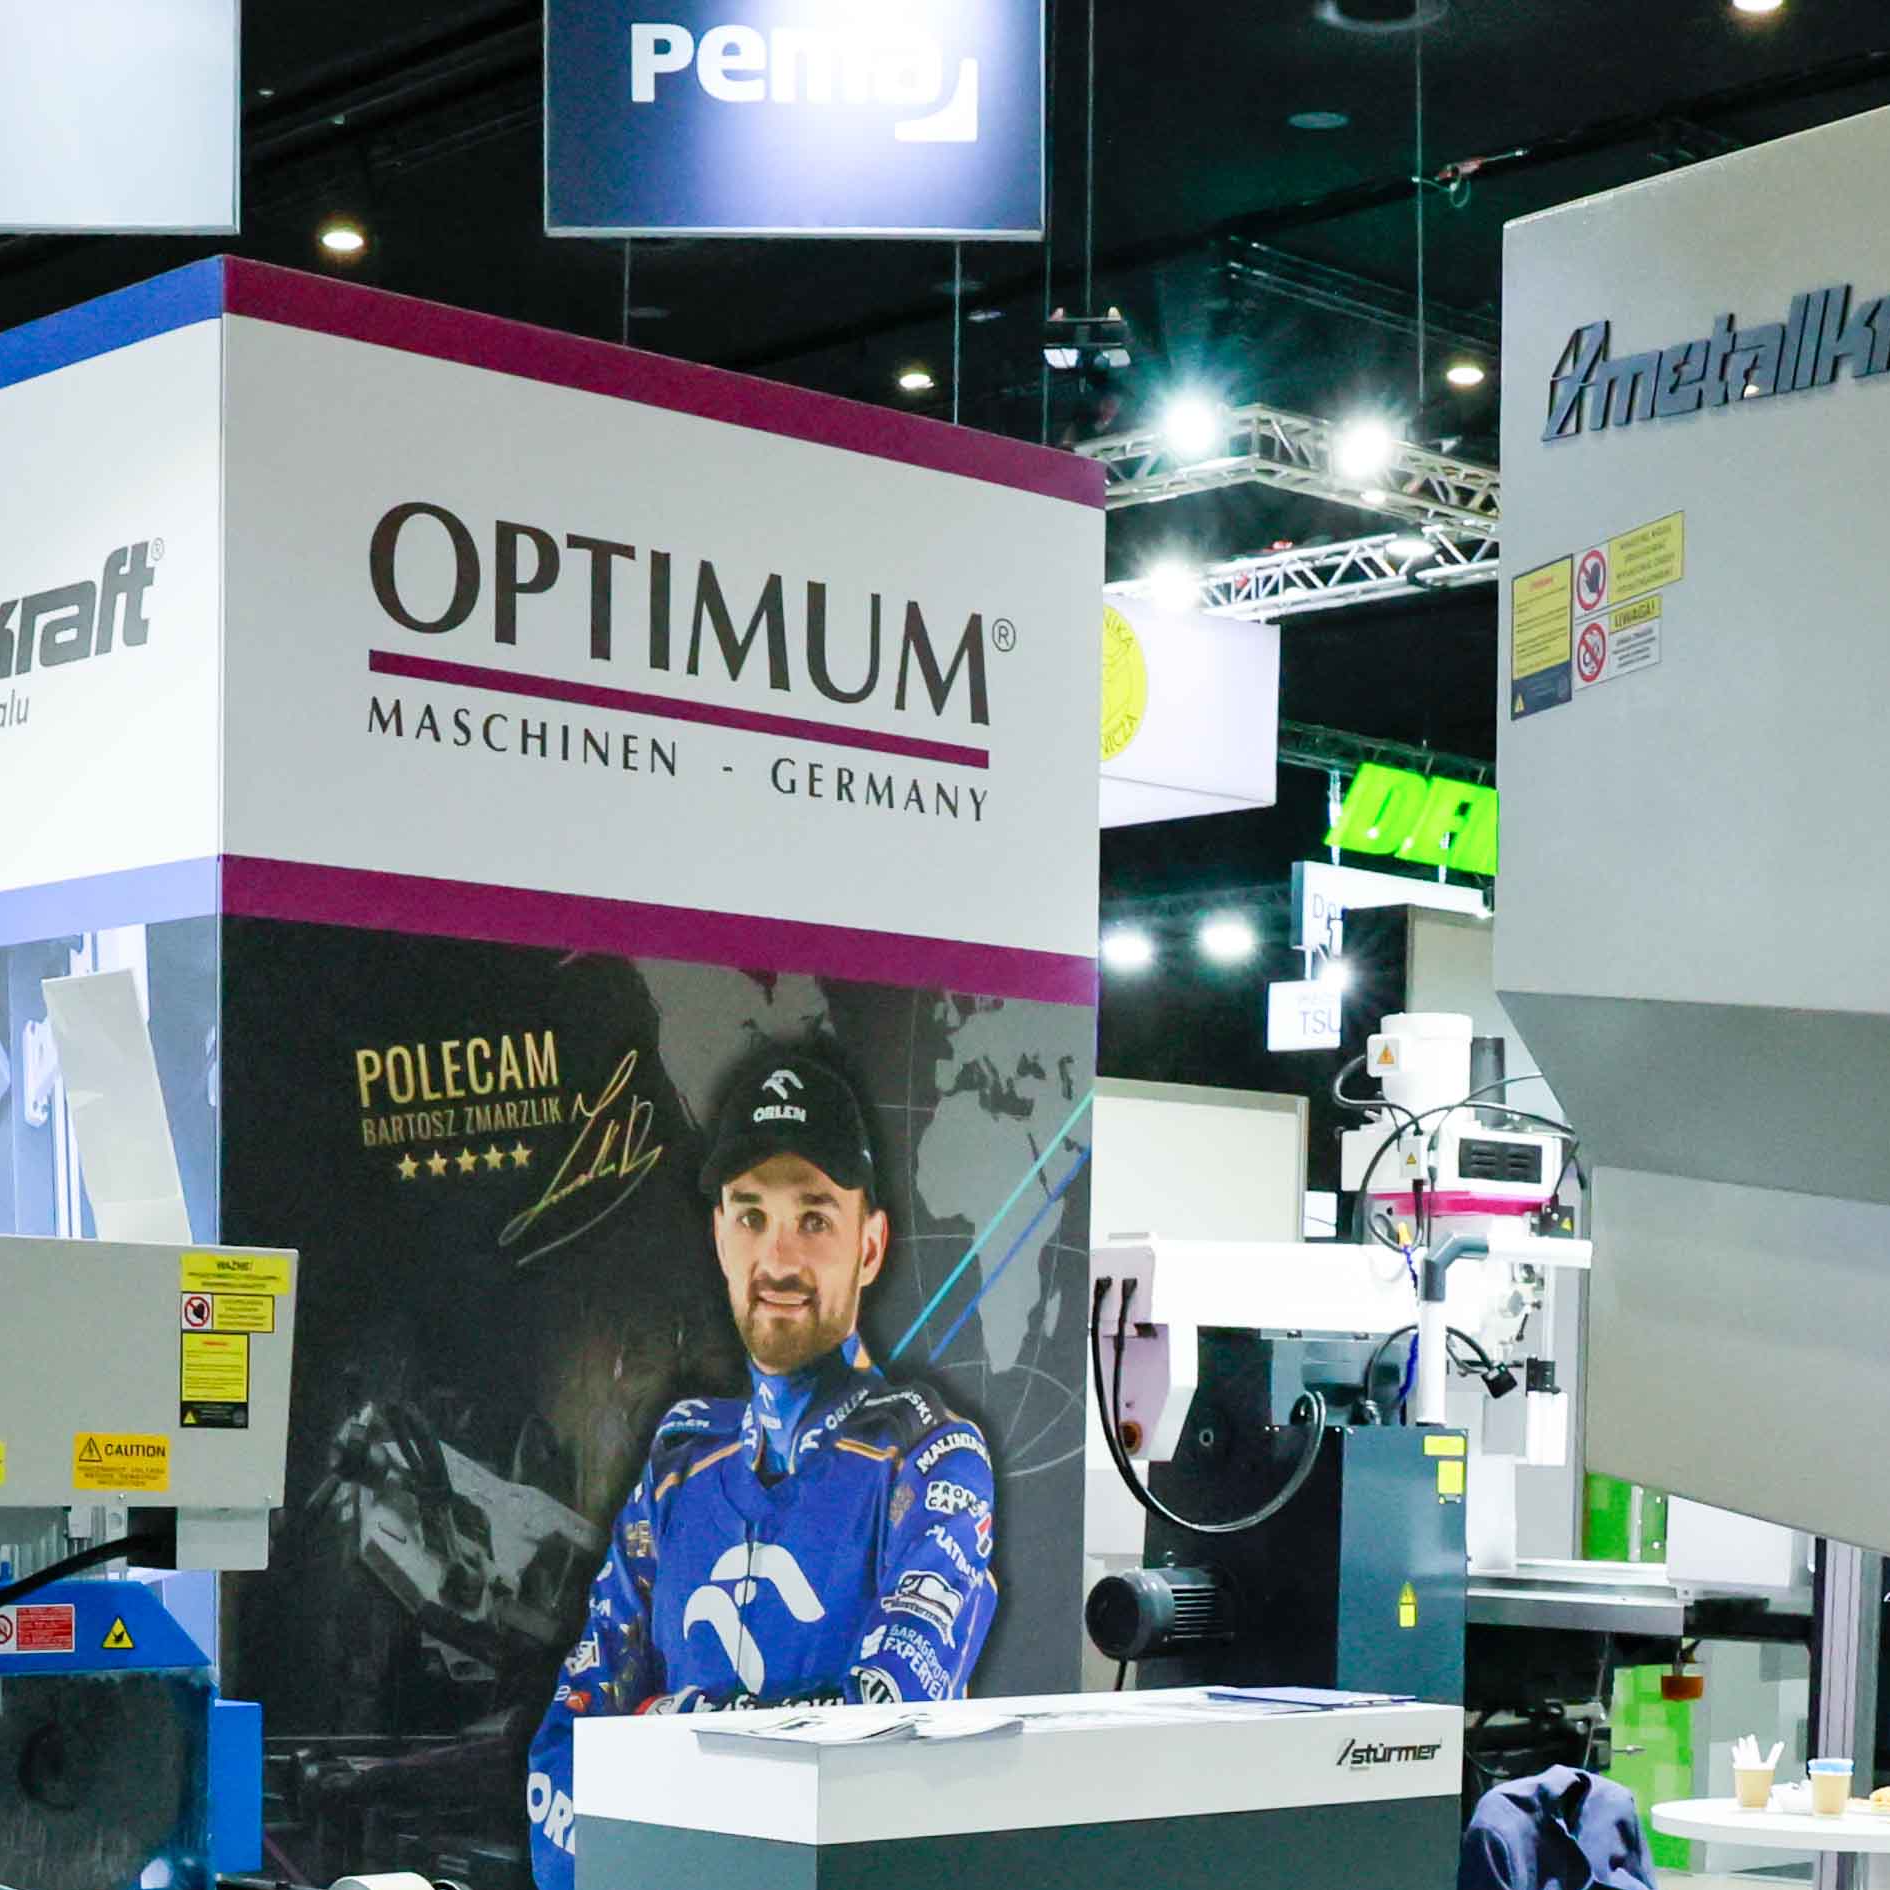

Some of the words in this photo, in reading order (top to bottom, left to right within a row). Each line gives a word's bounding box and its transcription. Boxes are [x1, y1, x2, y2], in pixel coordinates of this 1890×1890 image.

[368, 501, 990, 726] OPTIMUM
[367, 697, 679, 778] MASCHINEN
[771, 757, 989, 822] GERMANY
[355, 1030, 559, 1108] POLECAM
[362, 1108, 457, 1147] BARTOSZ
[463, 1096, 563, 1135] ZMARZLIK
[104, 1443, 166, 1458] CAUTION
